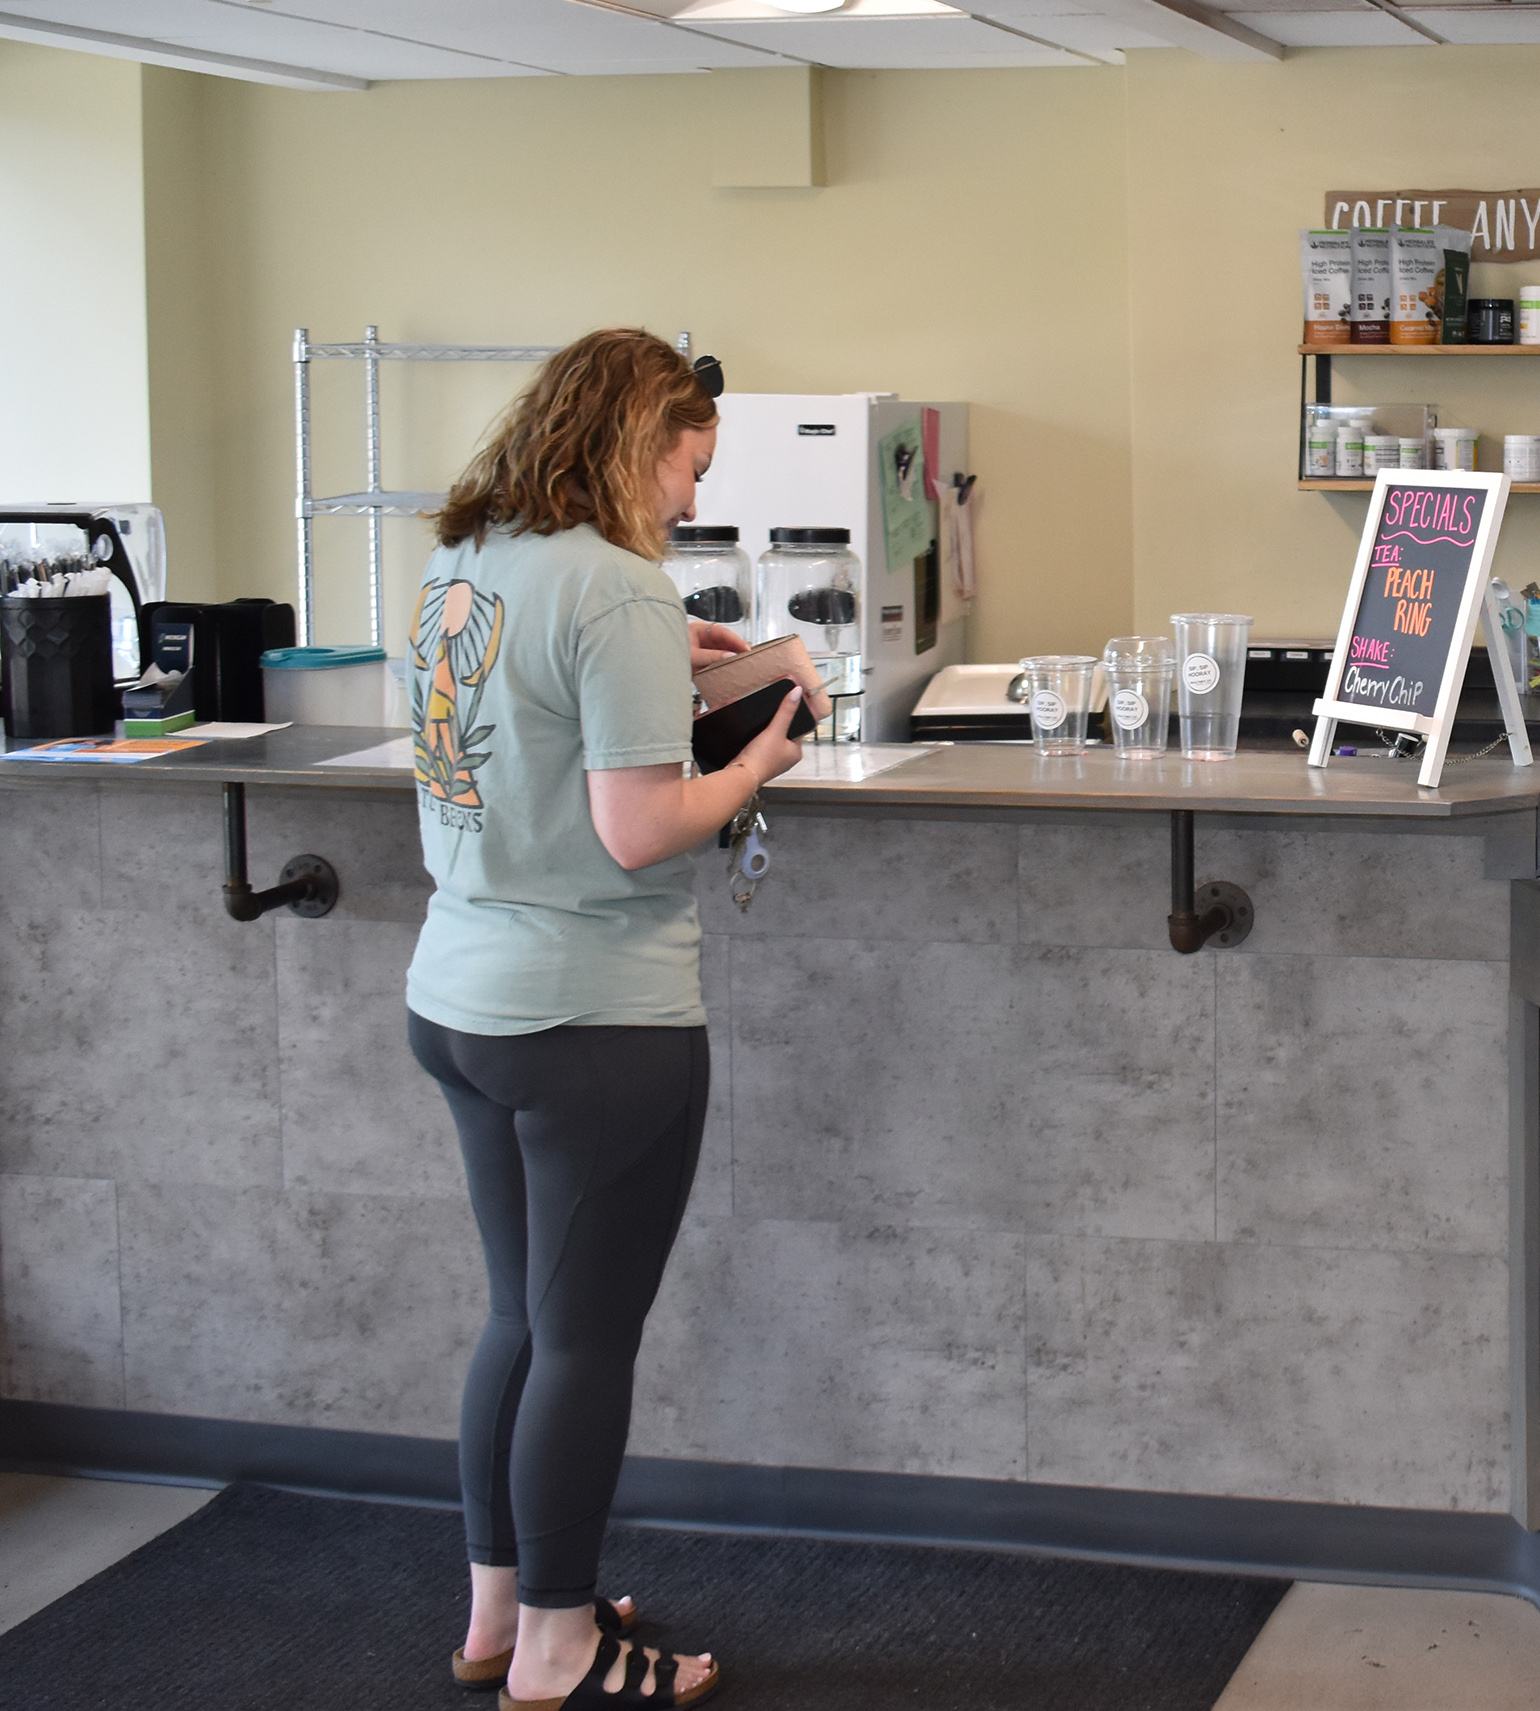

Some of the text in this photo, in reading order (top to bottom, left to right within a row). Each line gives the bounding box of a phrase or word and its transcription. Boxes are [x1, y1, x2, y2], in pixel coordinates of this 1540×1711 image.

[1385, 490, 1476, 535] SPECIALS
[1374, 544, 1404, 563] TEA:
[1383, 566, 1435, 600] PEACH
[1393, 599, 1433, 637] RING
[1350, 636, 1396, 662] SHAKE:
[1344, 665, 1390, 705] Cherry
